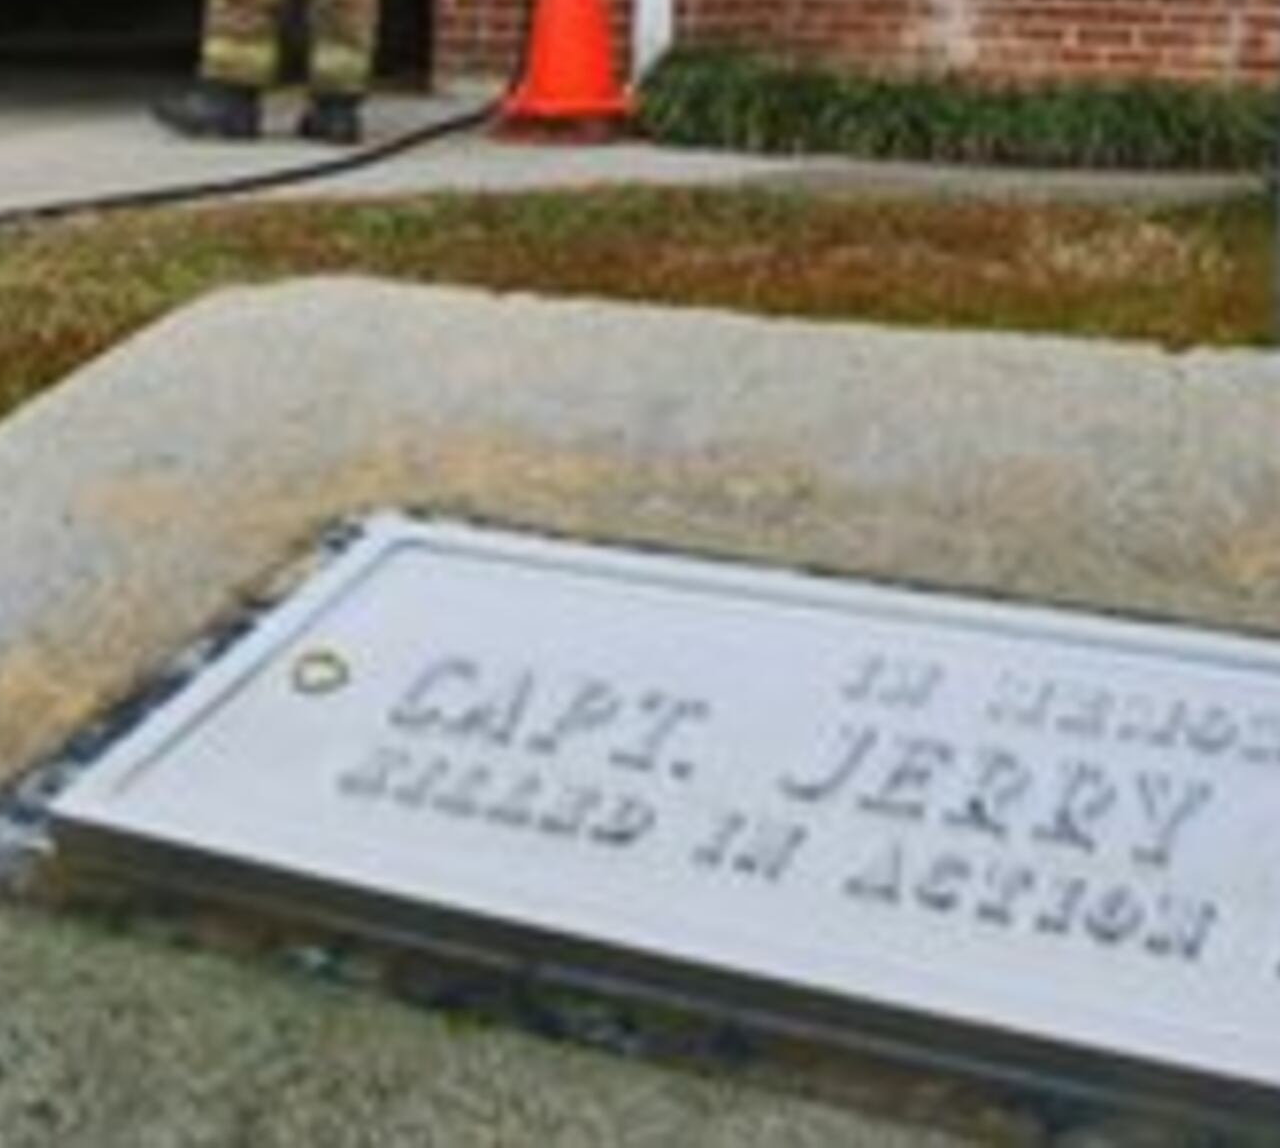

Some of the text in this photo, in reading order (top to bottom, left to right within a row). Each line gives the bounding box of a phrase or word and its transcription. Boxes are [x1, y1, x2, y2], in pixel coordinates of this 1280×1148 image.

[337, 746, 657, 846] KILLED
[692, 812, 808, 883] IN
[842, 840, 1217, 960] ACTION
[388, 656, 710, 780] CAPT.
[778, 724, 1213, 867] JERRY
